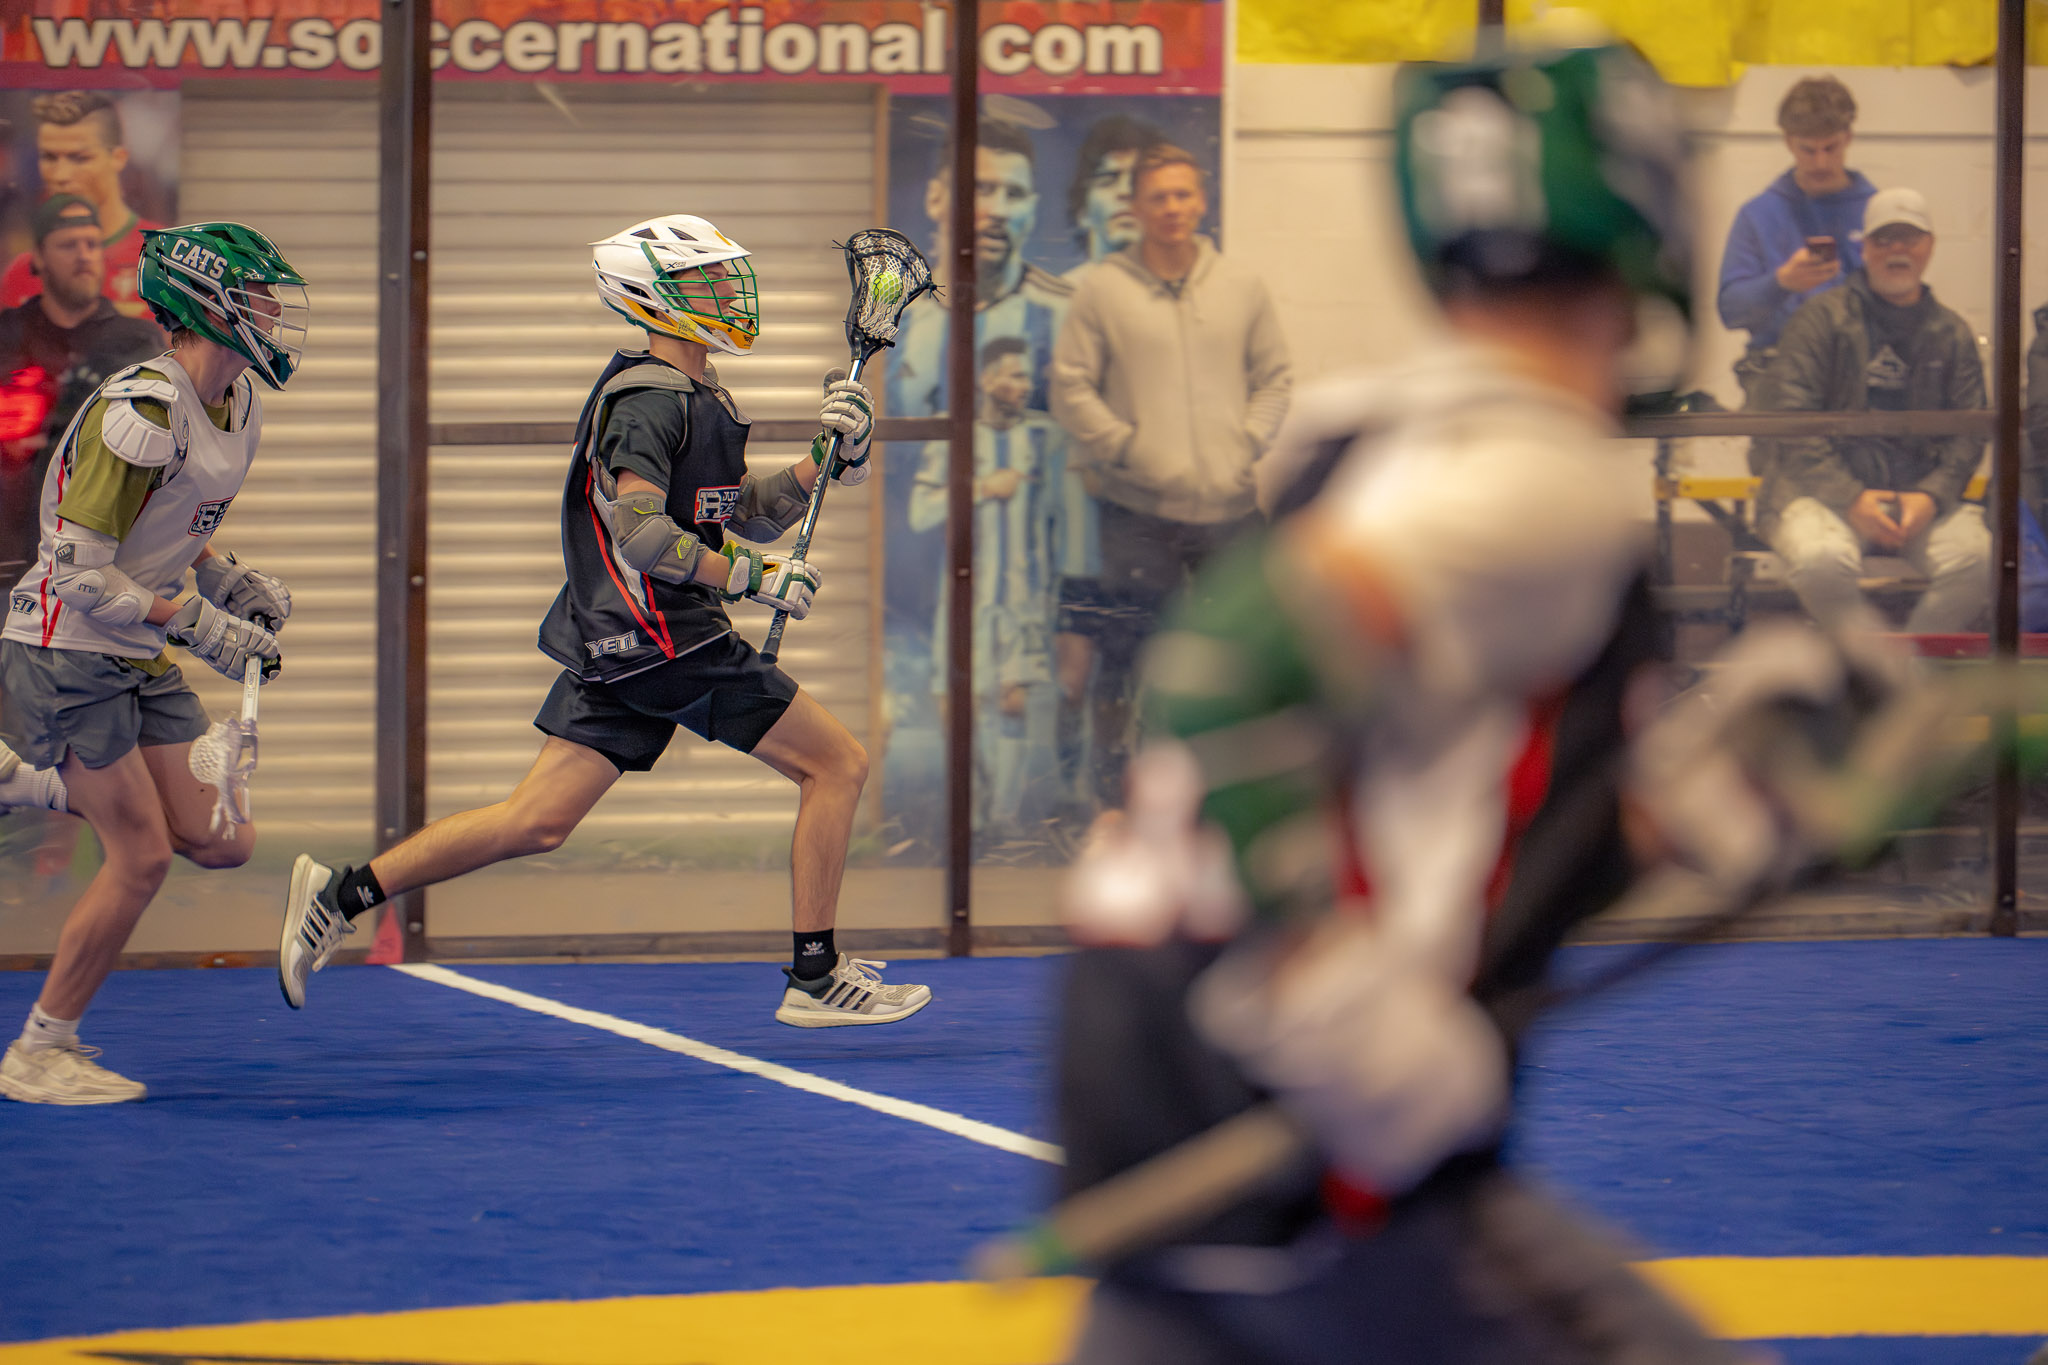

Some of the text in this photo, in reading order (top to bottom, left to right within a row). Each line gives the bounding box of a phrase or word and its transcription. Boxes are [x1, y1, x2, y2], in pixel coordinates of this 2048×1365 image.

[32, 7, 1163, 75] www.socernationalcom
[170, 238, 228, 280] CATS
[12, 595, 38, 615] ETI
[584, 630, 640, 659] YETI
